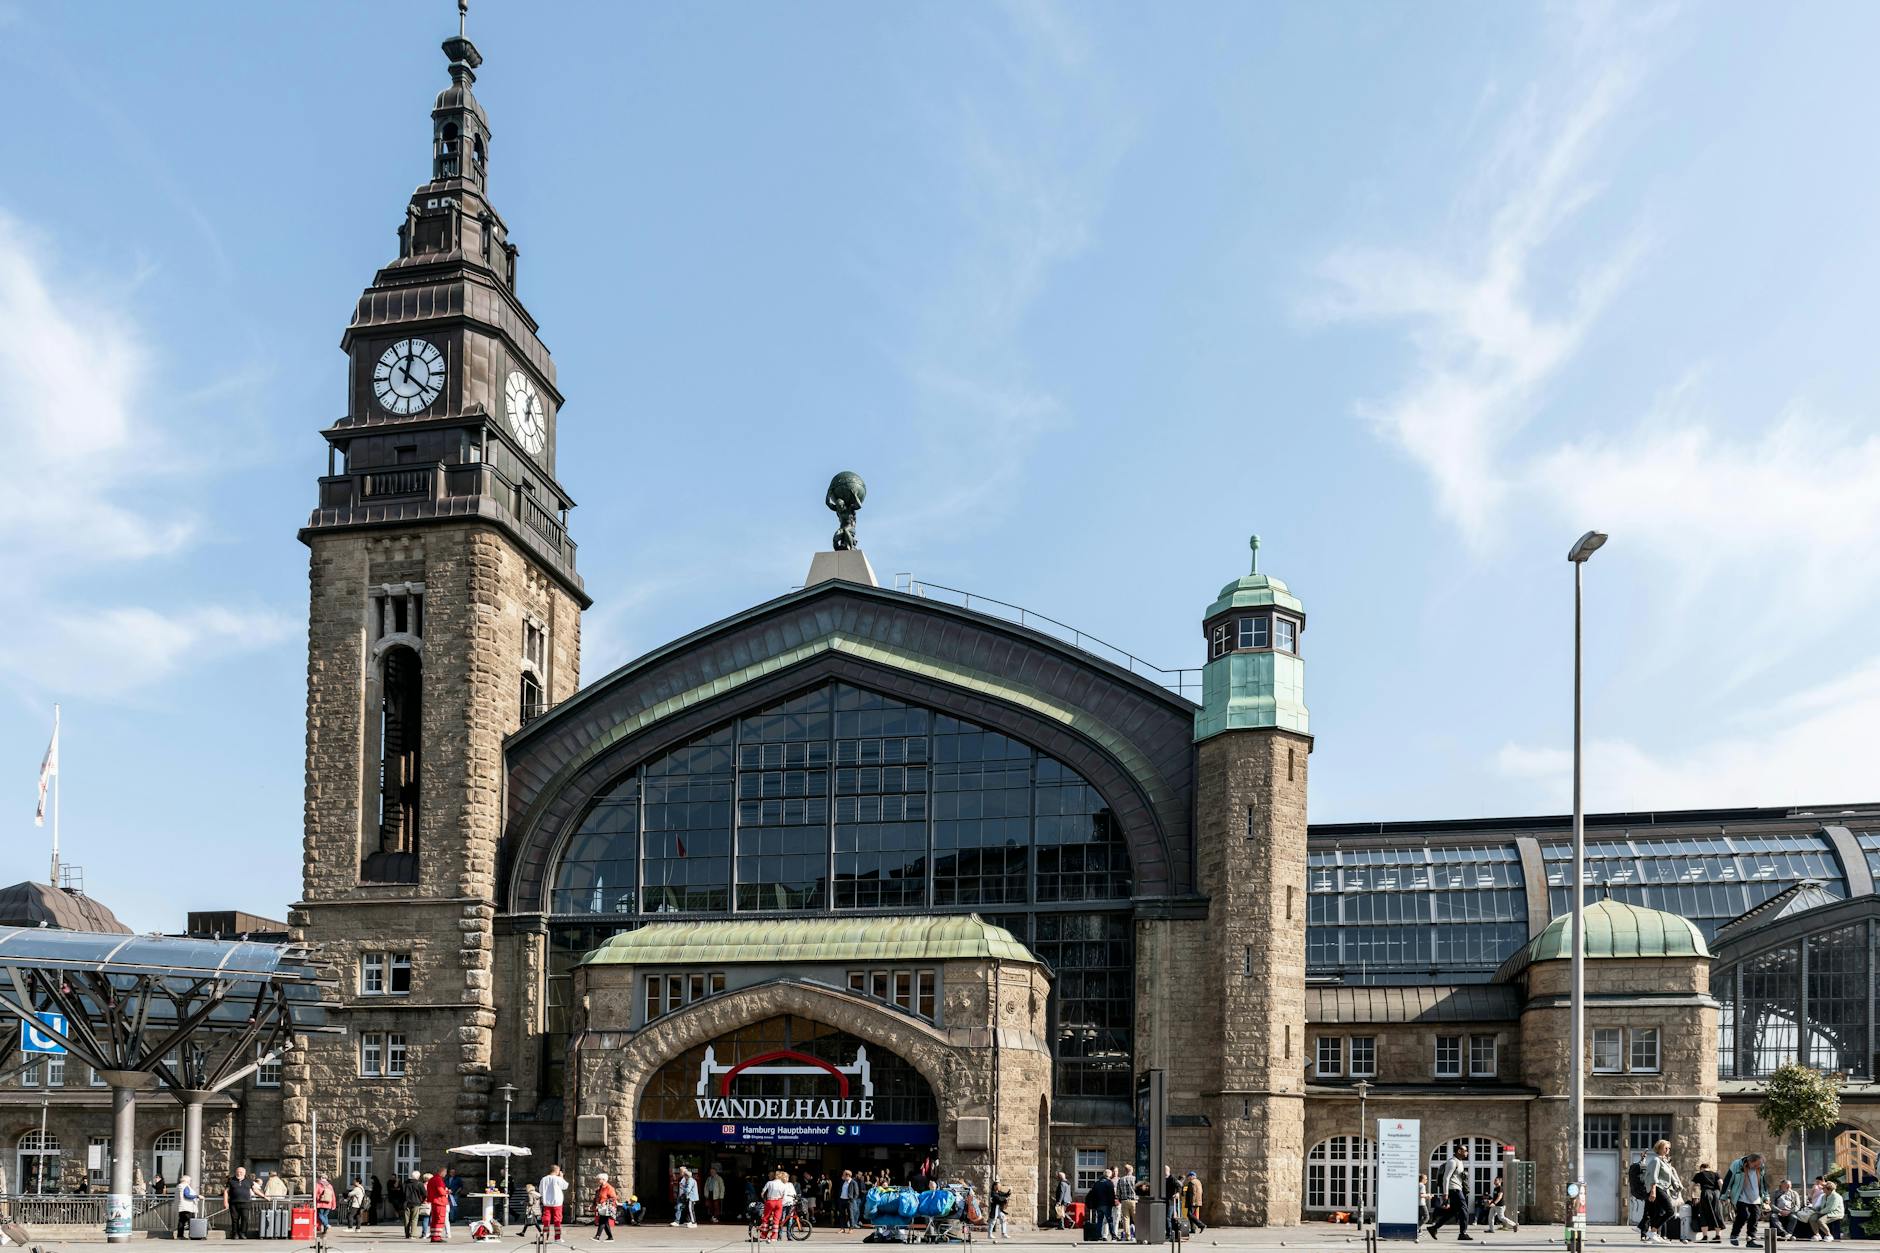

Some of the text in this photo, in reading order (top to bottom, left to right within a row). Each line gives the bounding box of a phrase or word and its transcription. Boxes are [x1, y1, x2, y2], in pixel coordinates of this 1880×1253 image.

[30, 1017, 61, 1049] U
[695, 1098, 875, 1121] WANDELHALLE
[723, 1125, 859, 1135] DB Hamburg Hauptbahnhof S U
